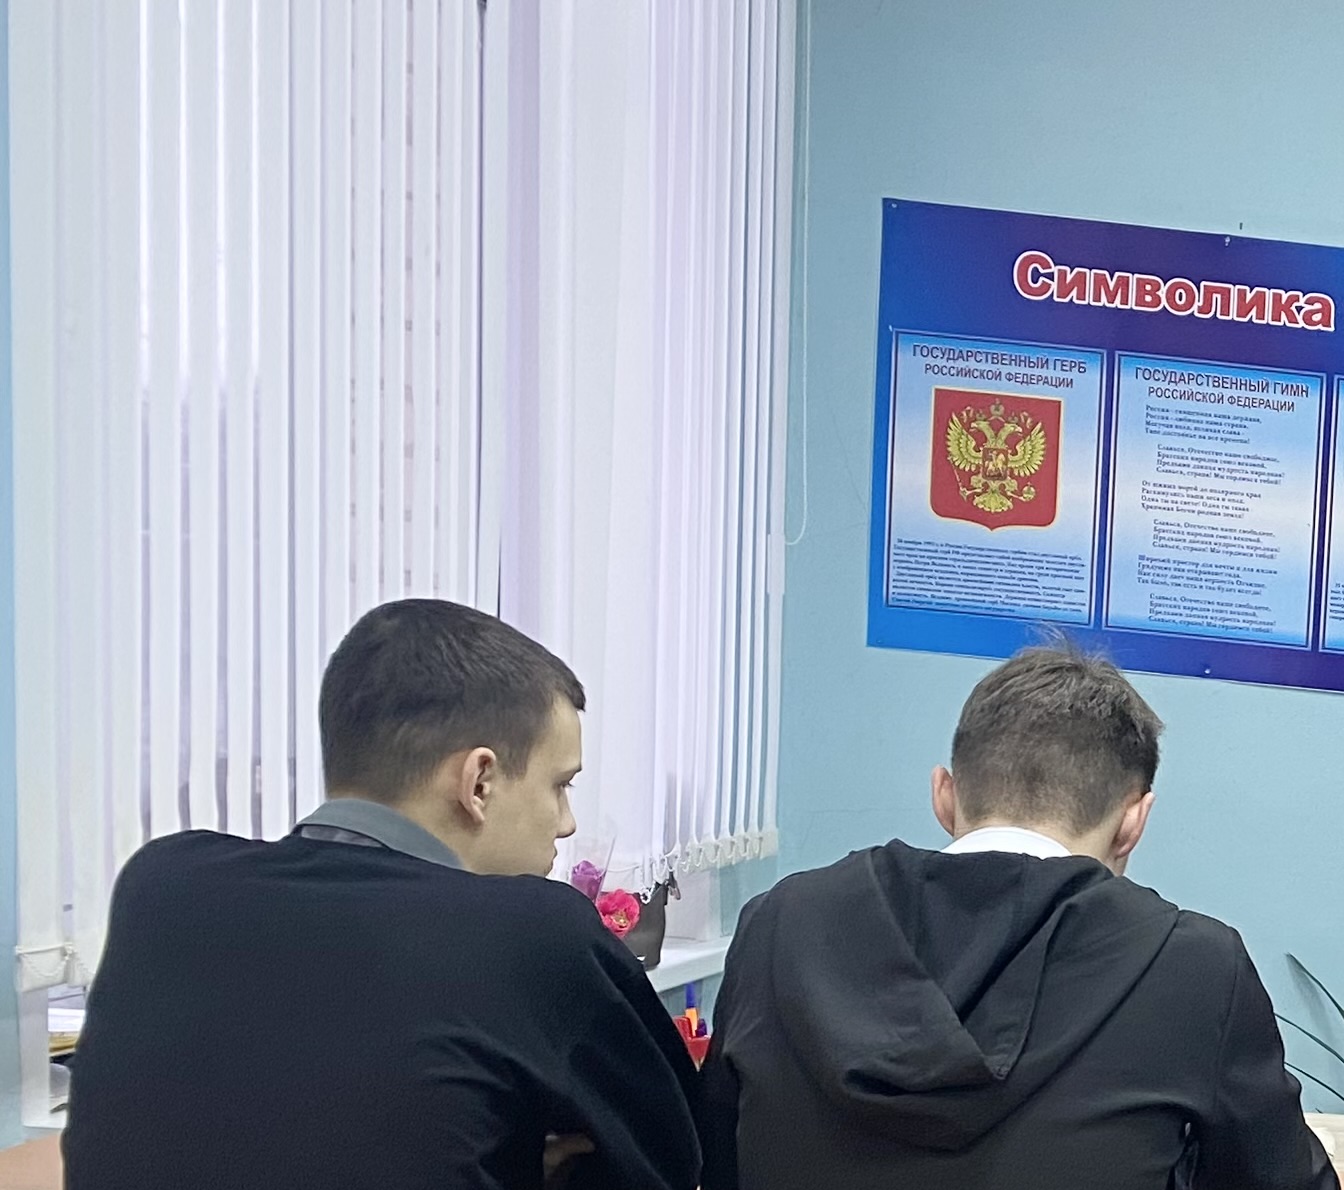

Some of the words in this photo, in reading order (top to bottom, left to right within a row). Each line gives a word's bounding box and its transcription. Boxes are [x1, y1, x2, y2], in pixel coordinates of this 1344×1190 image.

[1014, 251, 1335, 332] Символика
[912, 344, 1049, 370] ГОСУДАРСТВЕННЫЙ
[1053, 358, 1087, 374] ГЕРБ
[924, 363, 1002, 382] РОССИЙСКОЙ
[1005, 371, 1074, 389] ФЕДЕРАЦИИ
[1135, 366, 1269, 393] ГОСУДАРСТВЕННЫЙ
[1273, 381, 1309, 398] ГИМН
[1148, 386, 1224, 405] РОССИЙСКОЙ
[1227, 395, 1295, 412] ФЕДЕРАЦИИ
